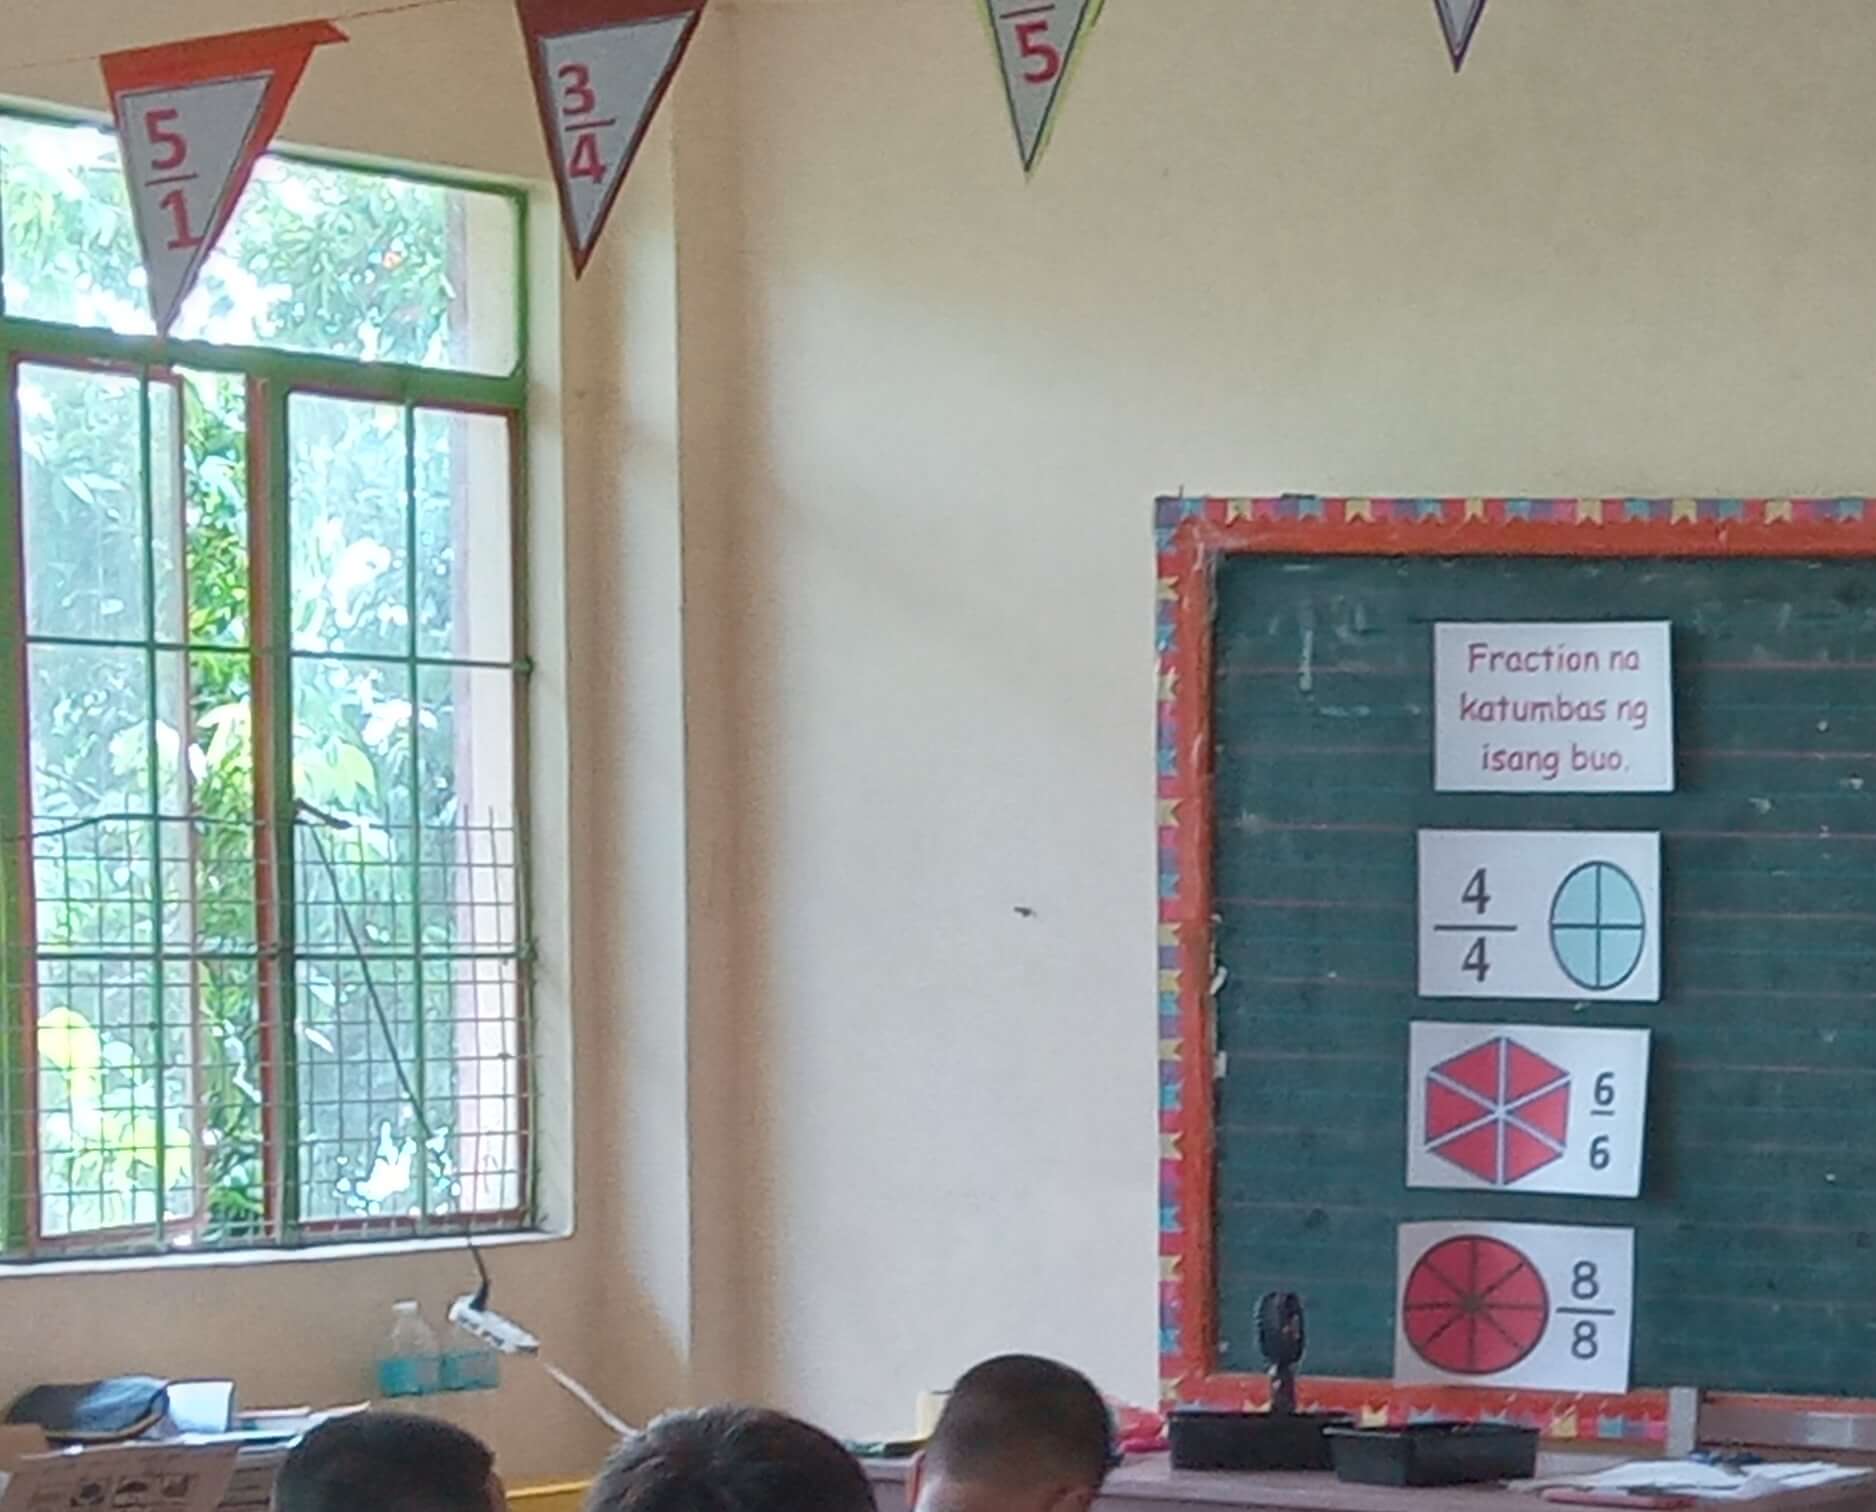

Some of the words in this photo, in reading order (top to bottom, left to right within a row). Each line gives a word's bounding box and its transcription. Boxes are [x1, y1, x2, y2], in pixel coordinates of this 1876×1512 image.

[1015, 20, 1061, 84] 5
[558, 64, 596, 118] 3
[145, 109, 187, 171] 5
[568, 132, 607, 185] 4
[158, 189, 205, 251] 1
[1468, 643, 1599, 673] Fraction
[1609, 651, 1640, 672] na
[1460, 692, 1606, 723] katumbas
[1617, 702, 1647, 730] ng
[1482, 745, 1559, 780] isang
[1572, 743, 1630, 772] buo.
[1461, 868, 1490, 914] 4
[1461, 937, 1490, 982] 4
[1594, 1072, 1616, 1106] 6
[1589, 1135, 1610, 1170] 6
[1571, 1260, 1599, 1300] 8
[1571, 1320, 1598, 1359] 8
